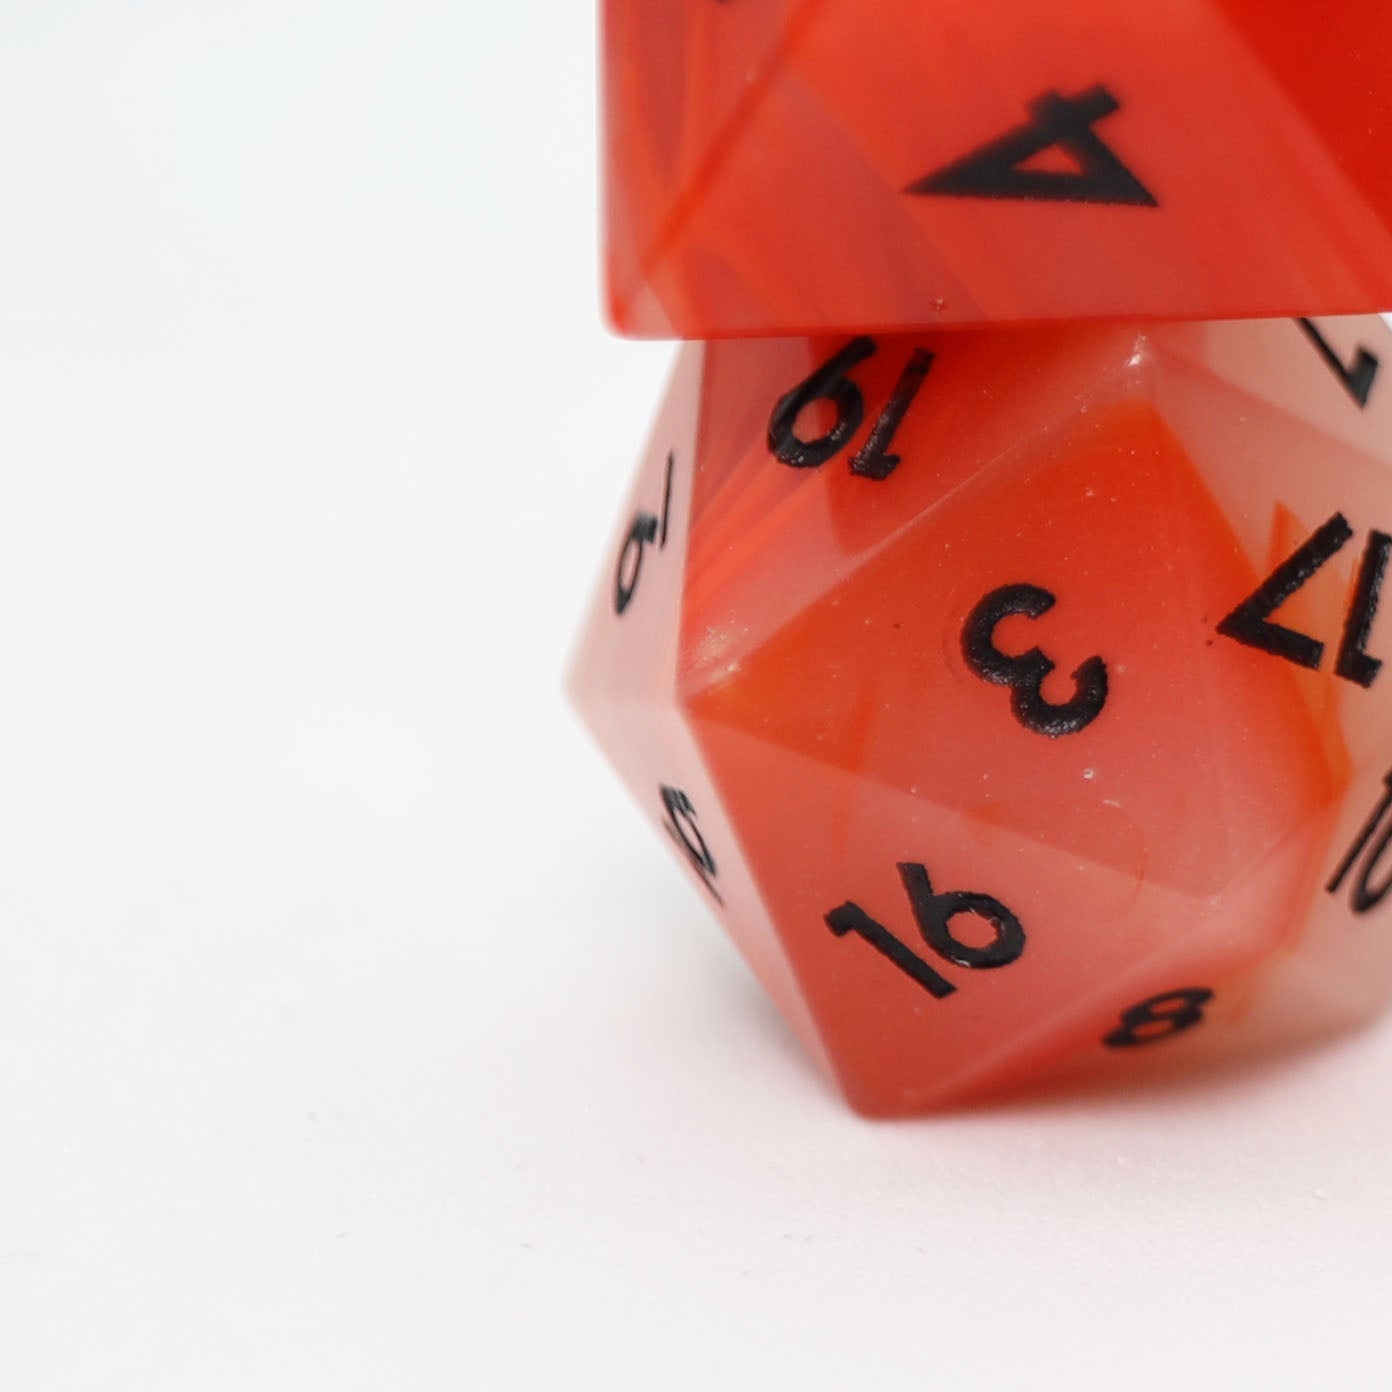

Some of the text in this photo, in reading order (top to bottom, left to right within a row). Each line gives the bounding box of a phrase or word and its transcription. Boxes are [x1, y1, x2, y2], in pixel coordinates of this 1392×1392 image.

[902, 83, 1160, 209] 4
[766, 334, 937, 481] 19
[962, 583, 1109, 738] 3
[824, 862, 1026, 999] 16
[1103, 986, 1214, 1049] 8
